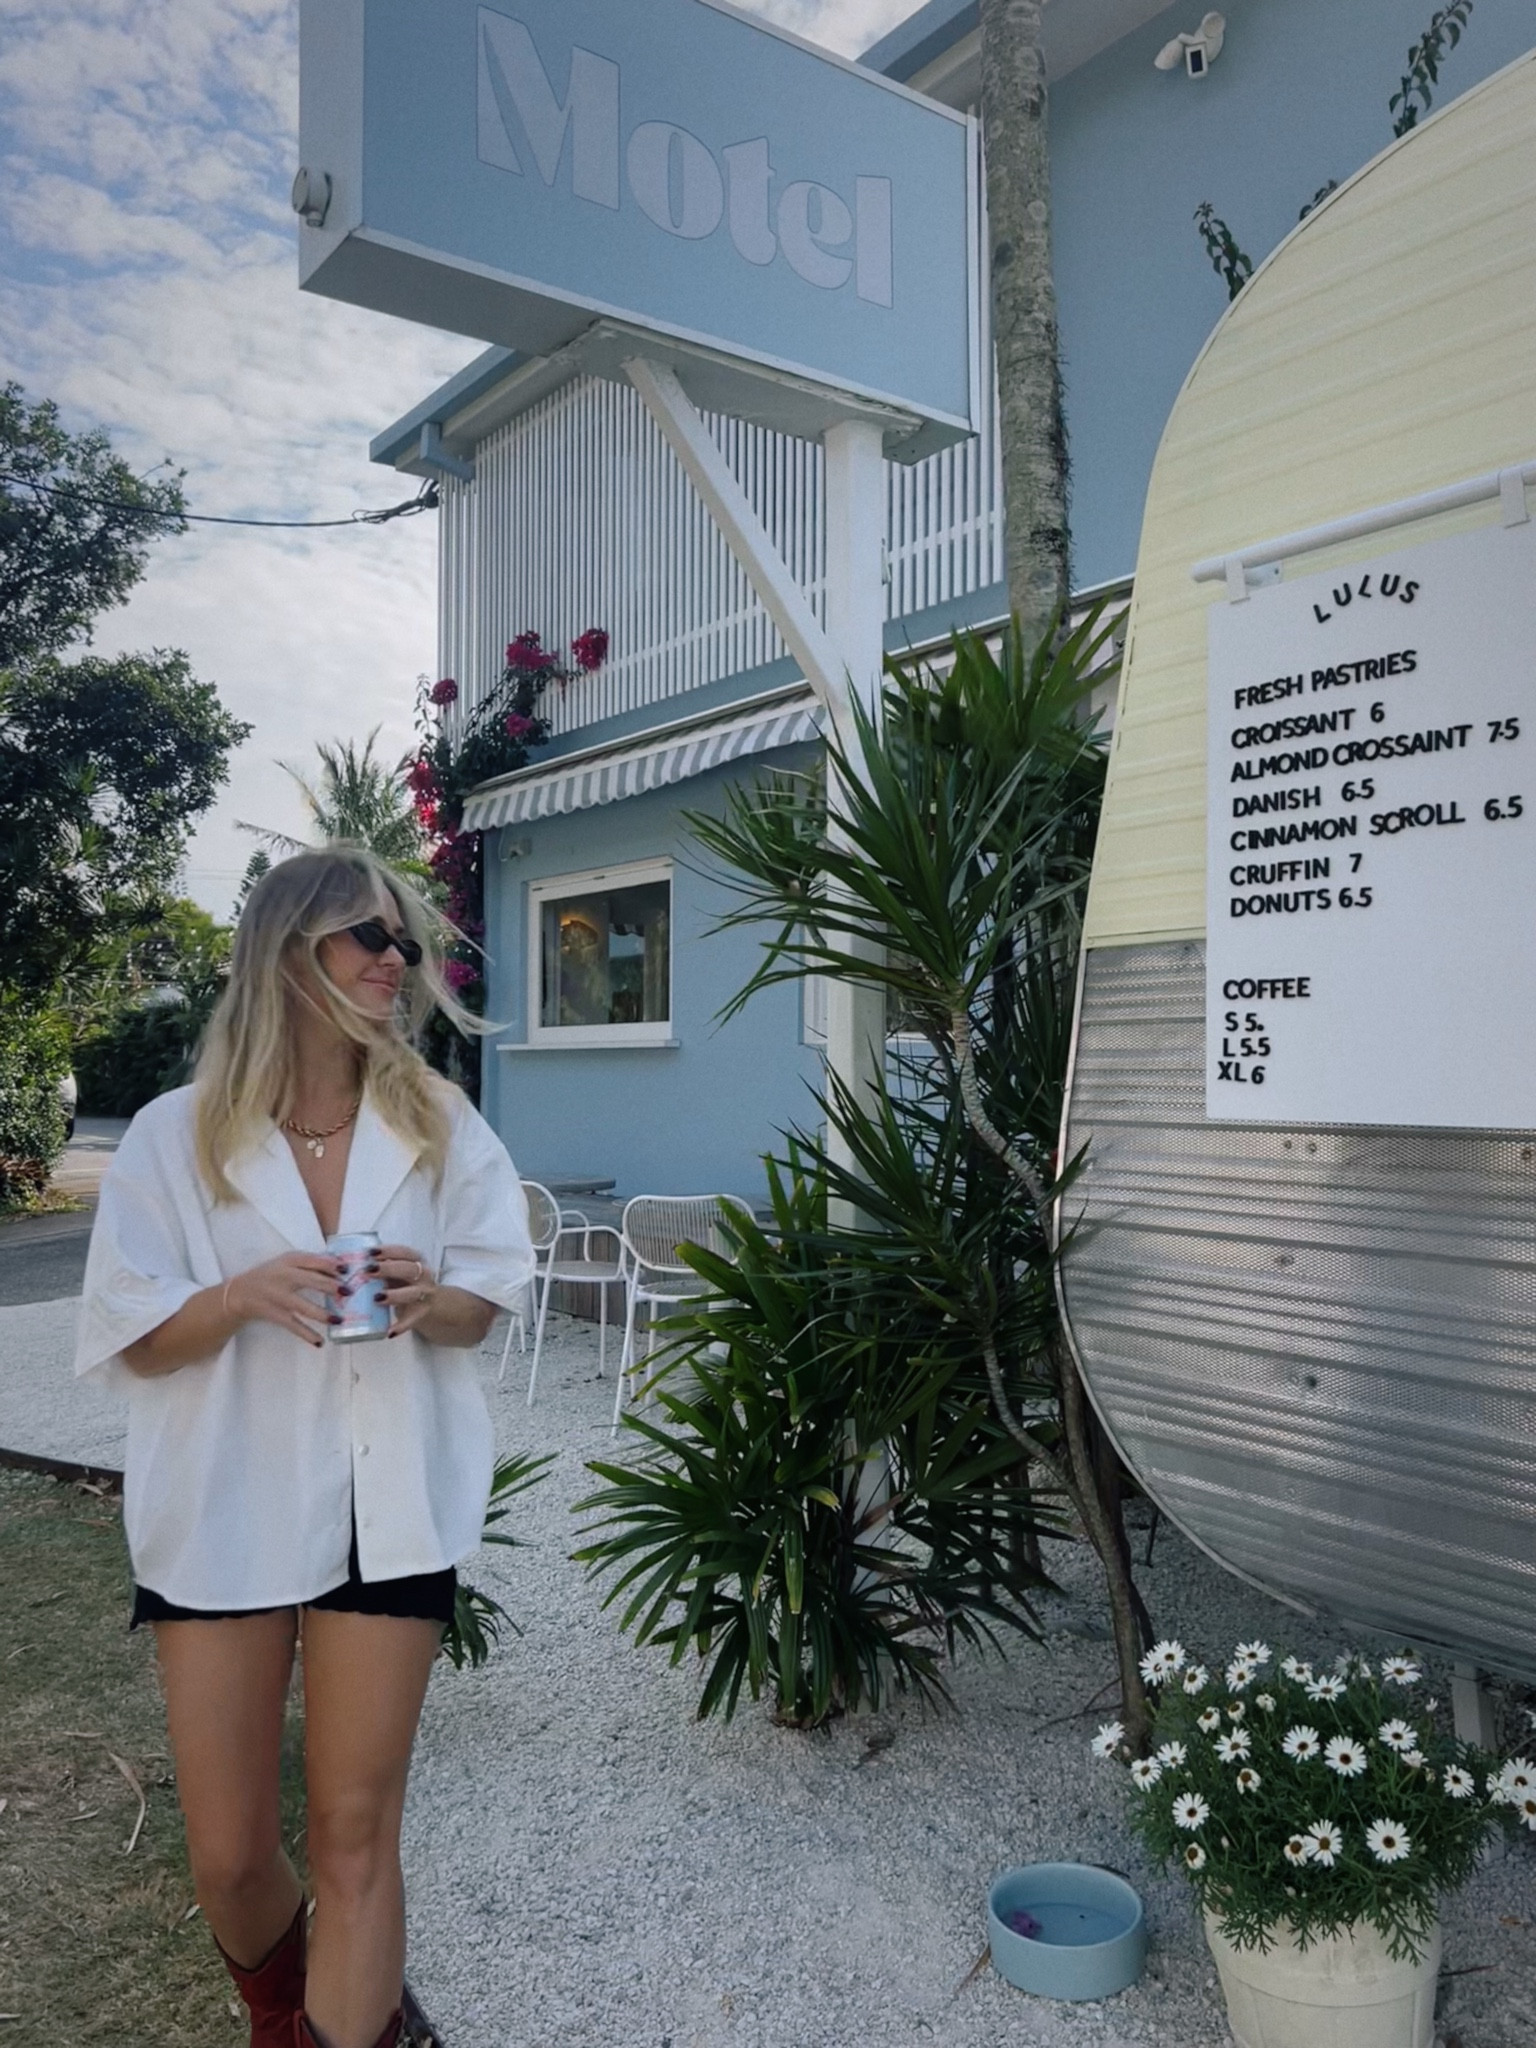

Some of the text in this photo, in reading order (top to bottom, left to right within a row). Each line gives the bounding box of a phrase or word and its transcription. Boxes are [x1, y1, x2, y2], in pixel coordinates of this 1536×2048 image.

[476, 4, 893, 310] Motel
[1313, 573, 1420, 624] LULUS
[1234, 649, 1417, 710] FRESH PASTRIES
[1230, 701, 1386, 750] CROISSANT 6
[1230, 746, 1330, 783] ALMOND
[1331, 724, 1474, 767] CROSSAINT
[1232, 777, 1375, 819] DANISH 6.5
[1229, 794, 1524, 852] CINNAMON SCROLL 6.5
[1229, 852, 1363, 887] CRUFFIN 7
[1230, 886, 1373, 918] DONUTS 6.5
[1222, 976, 1311, 1001] COFFEE
[1224, 1011, 1239, 1033] S
[1222, 1036, 1271, 1058] L 5.5
[1217, 1060, 1266, 1085] XL 6
